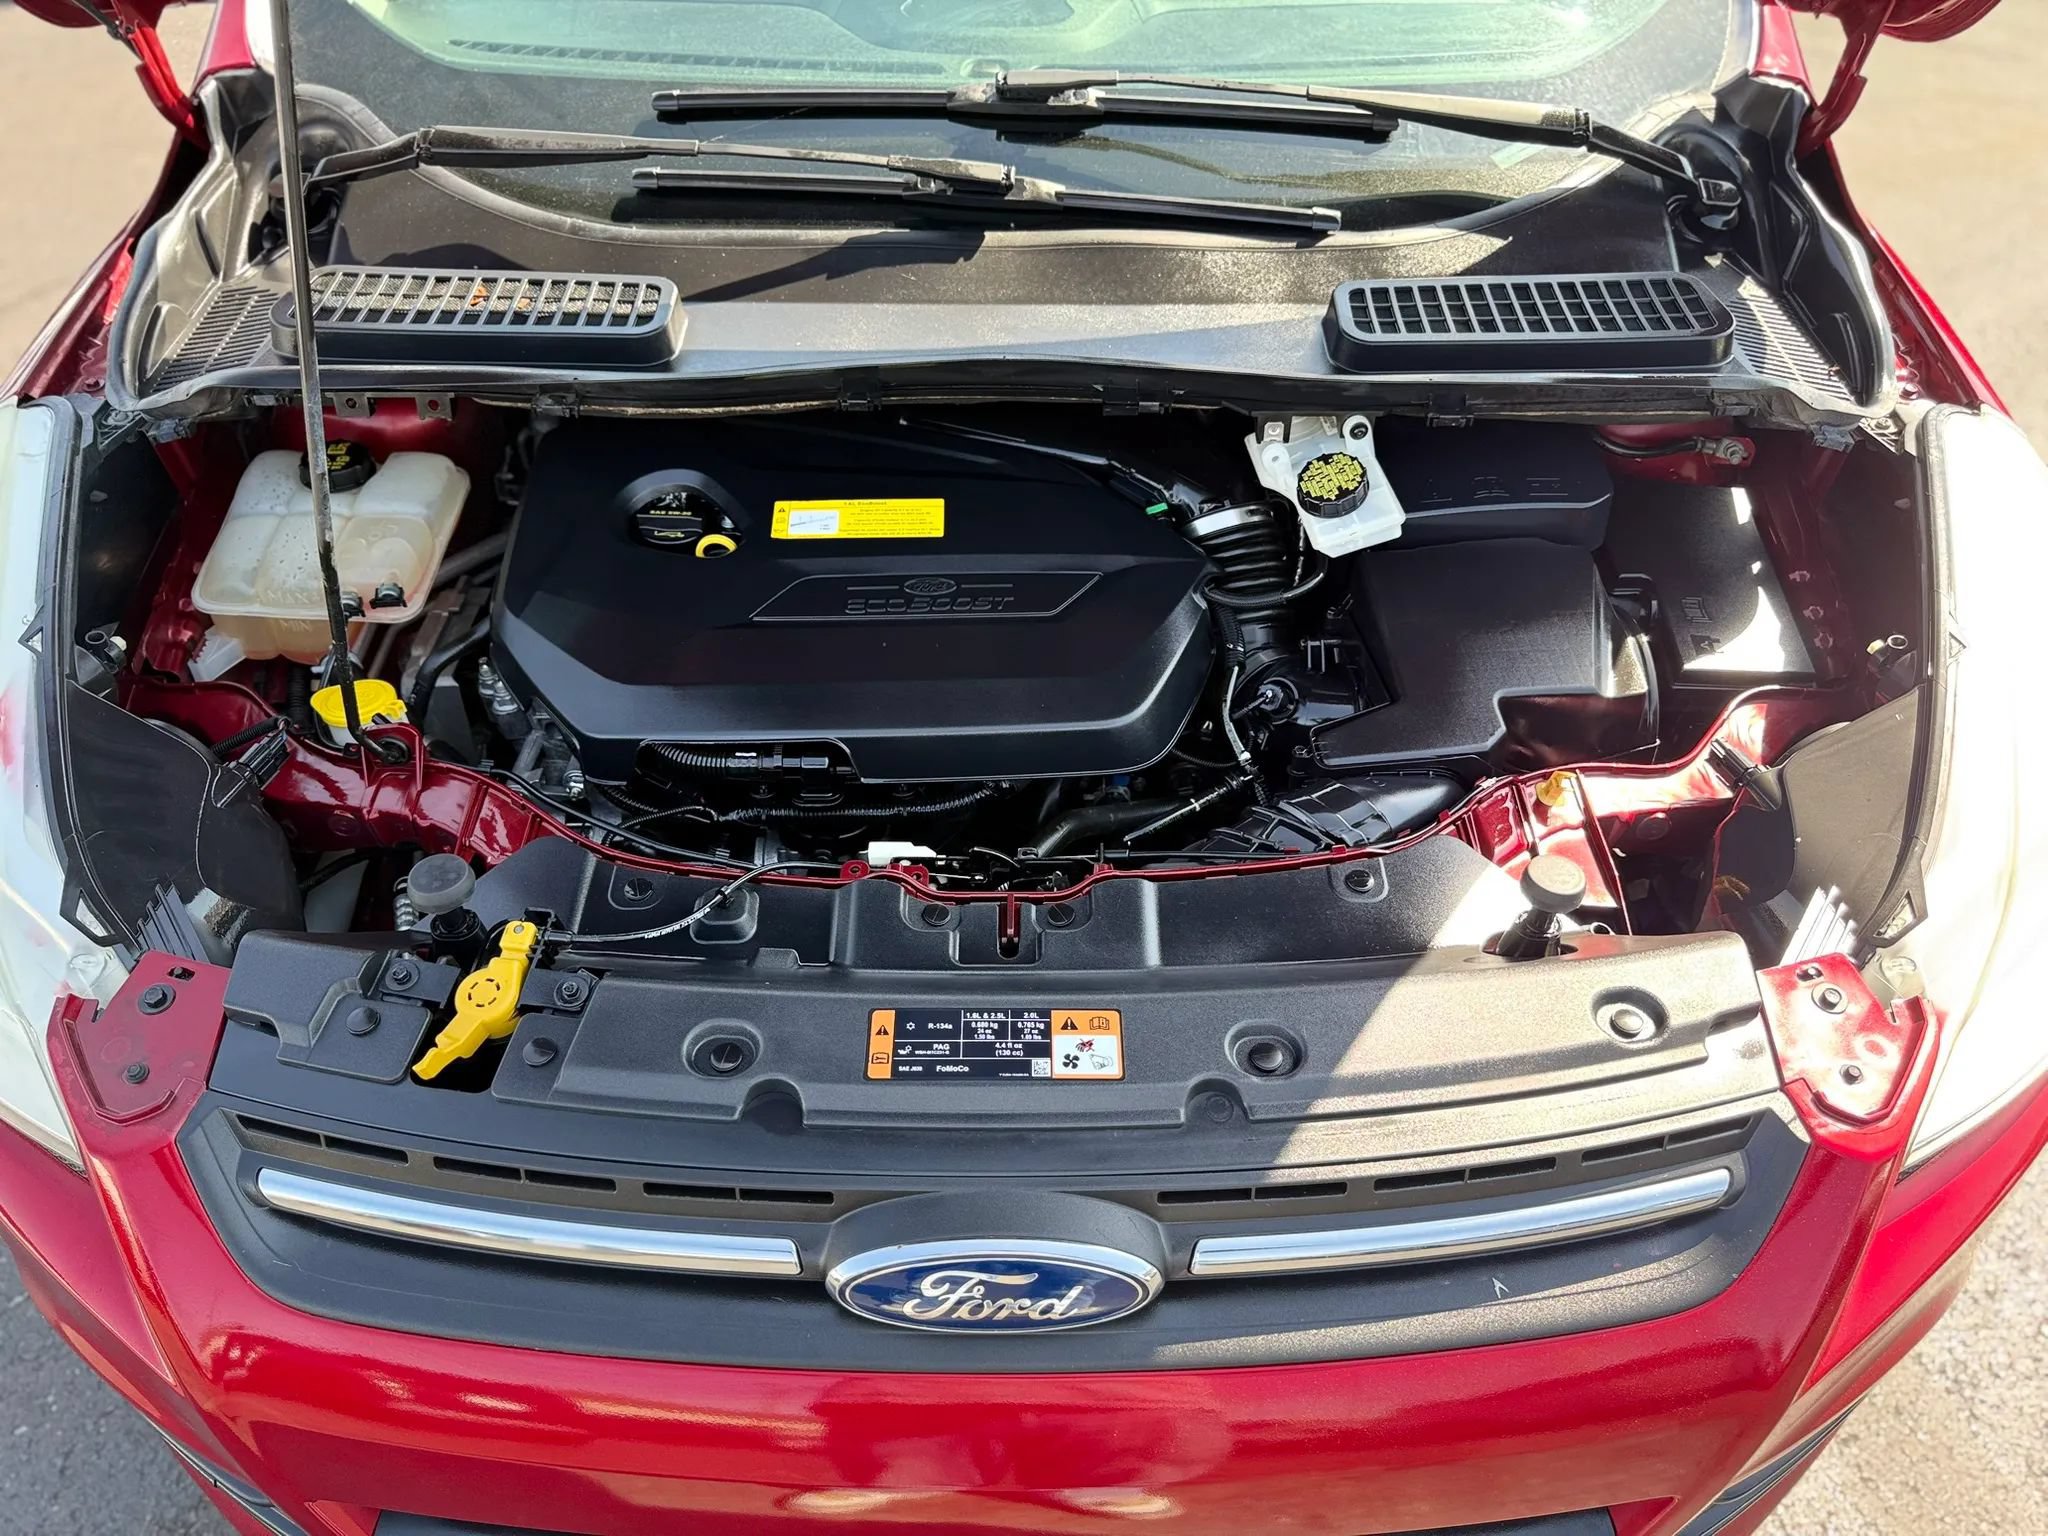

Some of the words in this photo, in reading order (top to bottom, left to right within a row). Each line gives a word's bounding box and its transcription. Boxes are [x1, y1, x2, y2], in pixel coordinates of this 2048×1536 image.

[845, 597, 1015, 614] ECOBOOST
[927, 1022, 953, 1030] R-134a
[989, 1021, 999, 1029] kg
[1036, 1021, 1045, 1030] kg
[995, 1049, 1011, 1057] (130
[1012, 1049, 1024, 1057] cc)
[902, 1270, 1084, 1321] Ford
